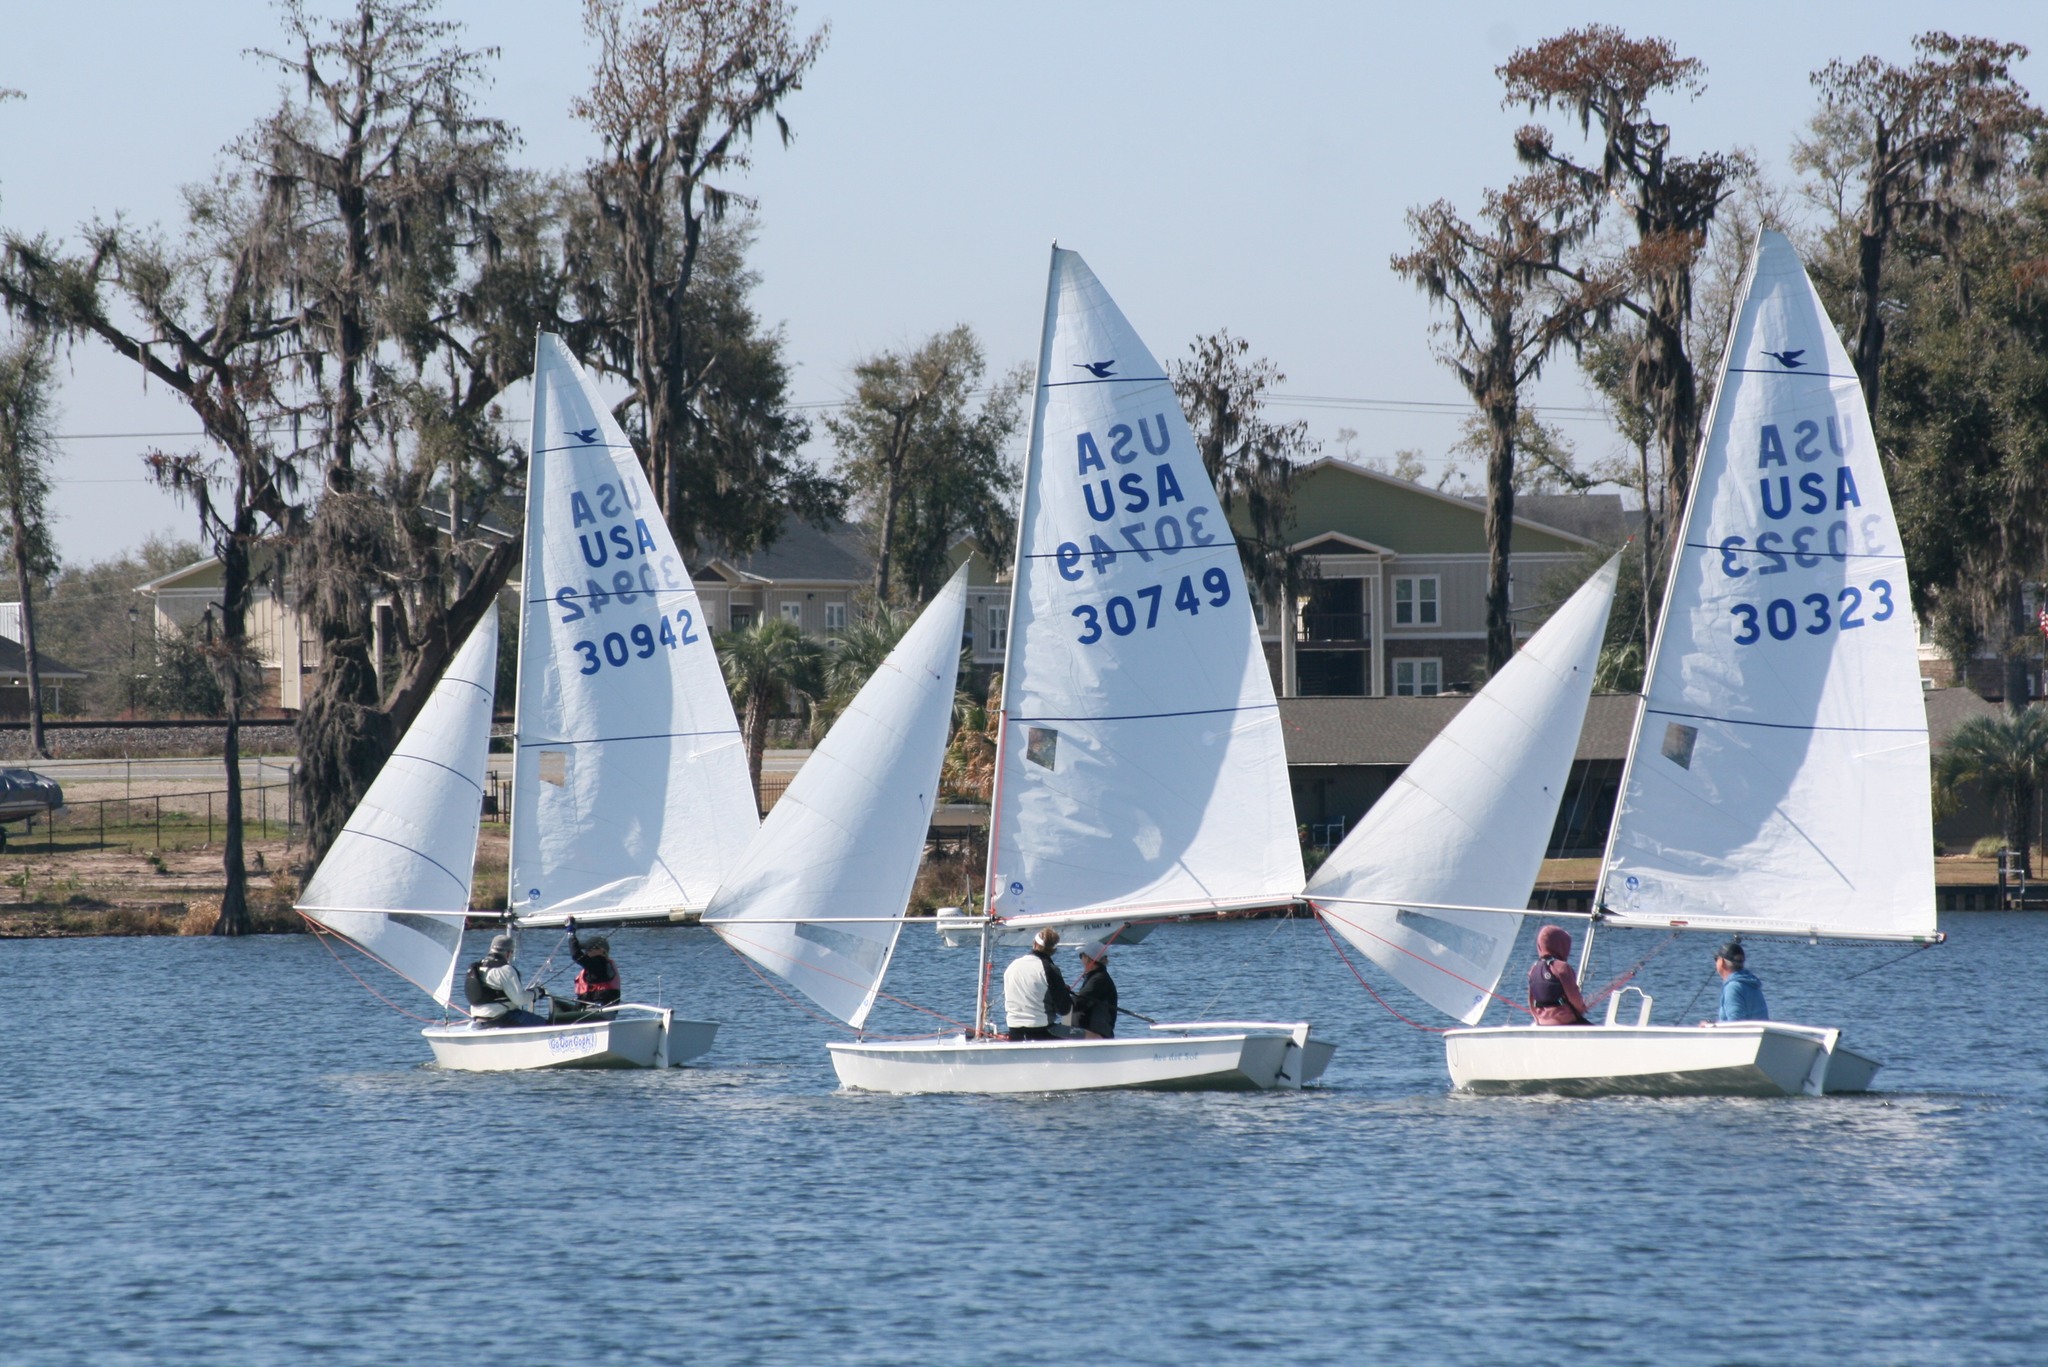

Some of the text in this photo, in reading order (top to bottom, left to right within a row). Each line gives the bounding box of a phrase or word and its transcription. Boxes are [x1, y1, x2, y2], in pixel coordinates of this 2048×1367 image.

[1082, 463, 1185, 522] USA
[1760, 466, 1861, 520] USA
[579, 518, 657, 568] USA
[1071, 567, 1230, 645] 30749
[1730, 579, 1894, 646] 30323
[573, 609, 698, 675] 30942
